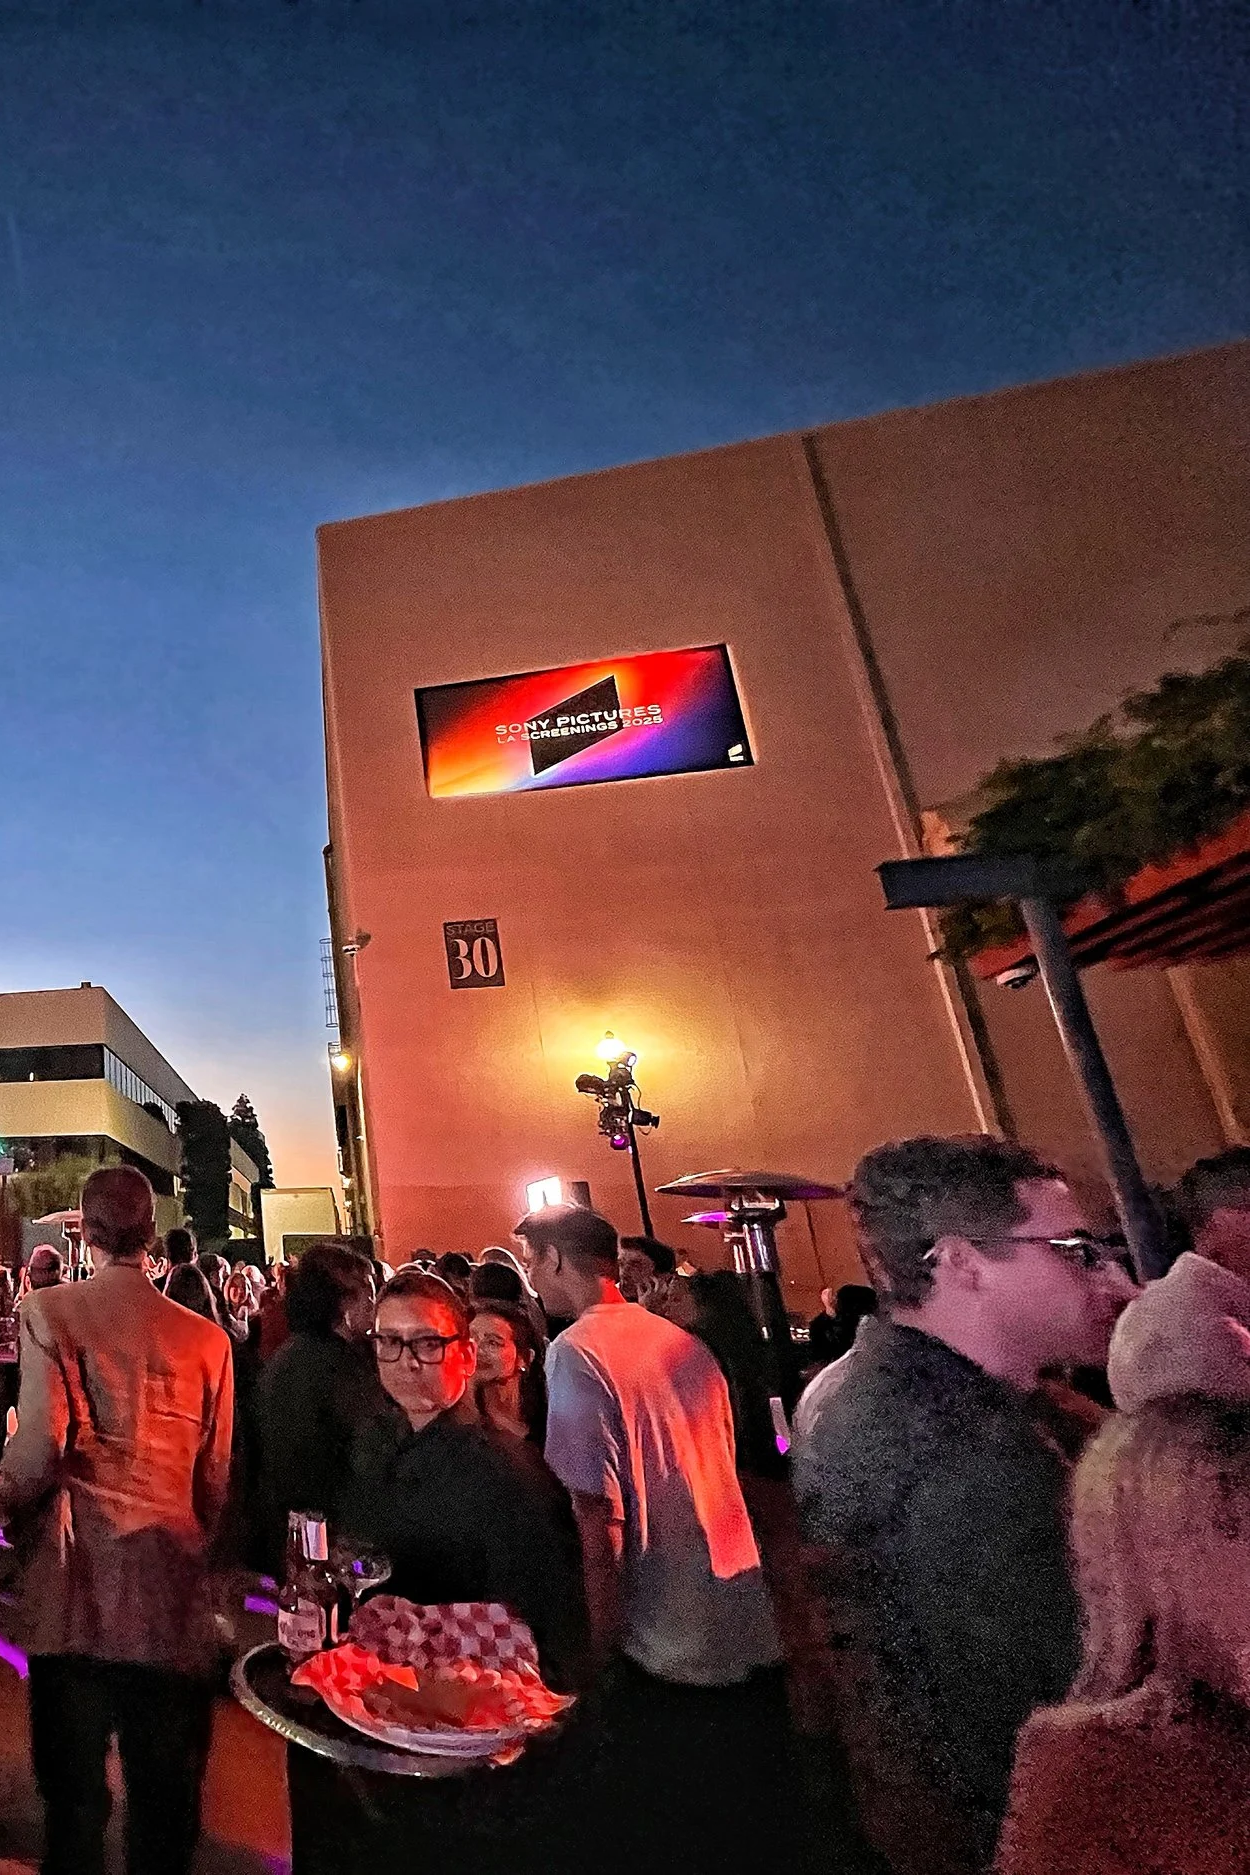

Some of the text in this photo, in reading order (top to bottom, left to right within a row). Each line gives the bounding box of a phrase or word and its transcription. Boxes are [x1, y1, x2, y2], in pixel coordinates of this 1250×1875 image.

[495, 704, 662, 735] SONY PICTURES
[497, 715, 664, 744] LA SCREENINGS 2025
[446, 921, 495, 935] STAGE
[451, 936, 498, 979] 30
